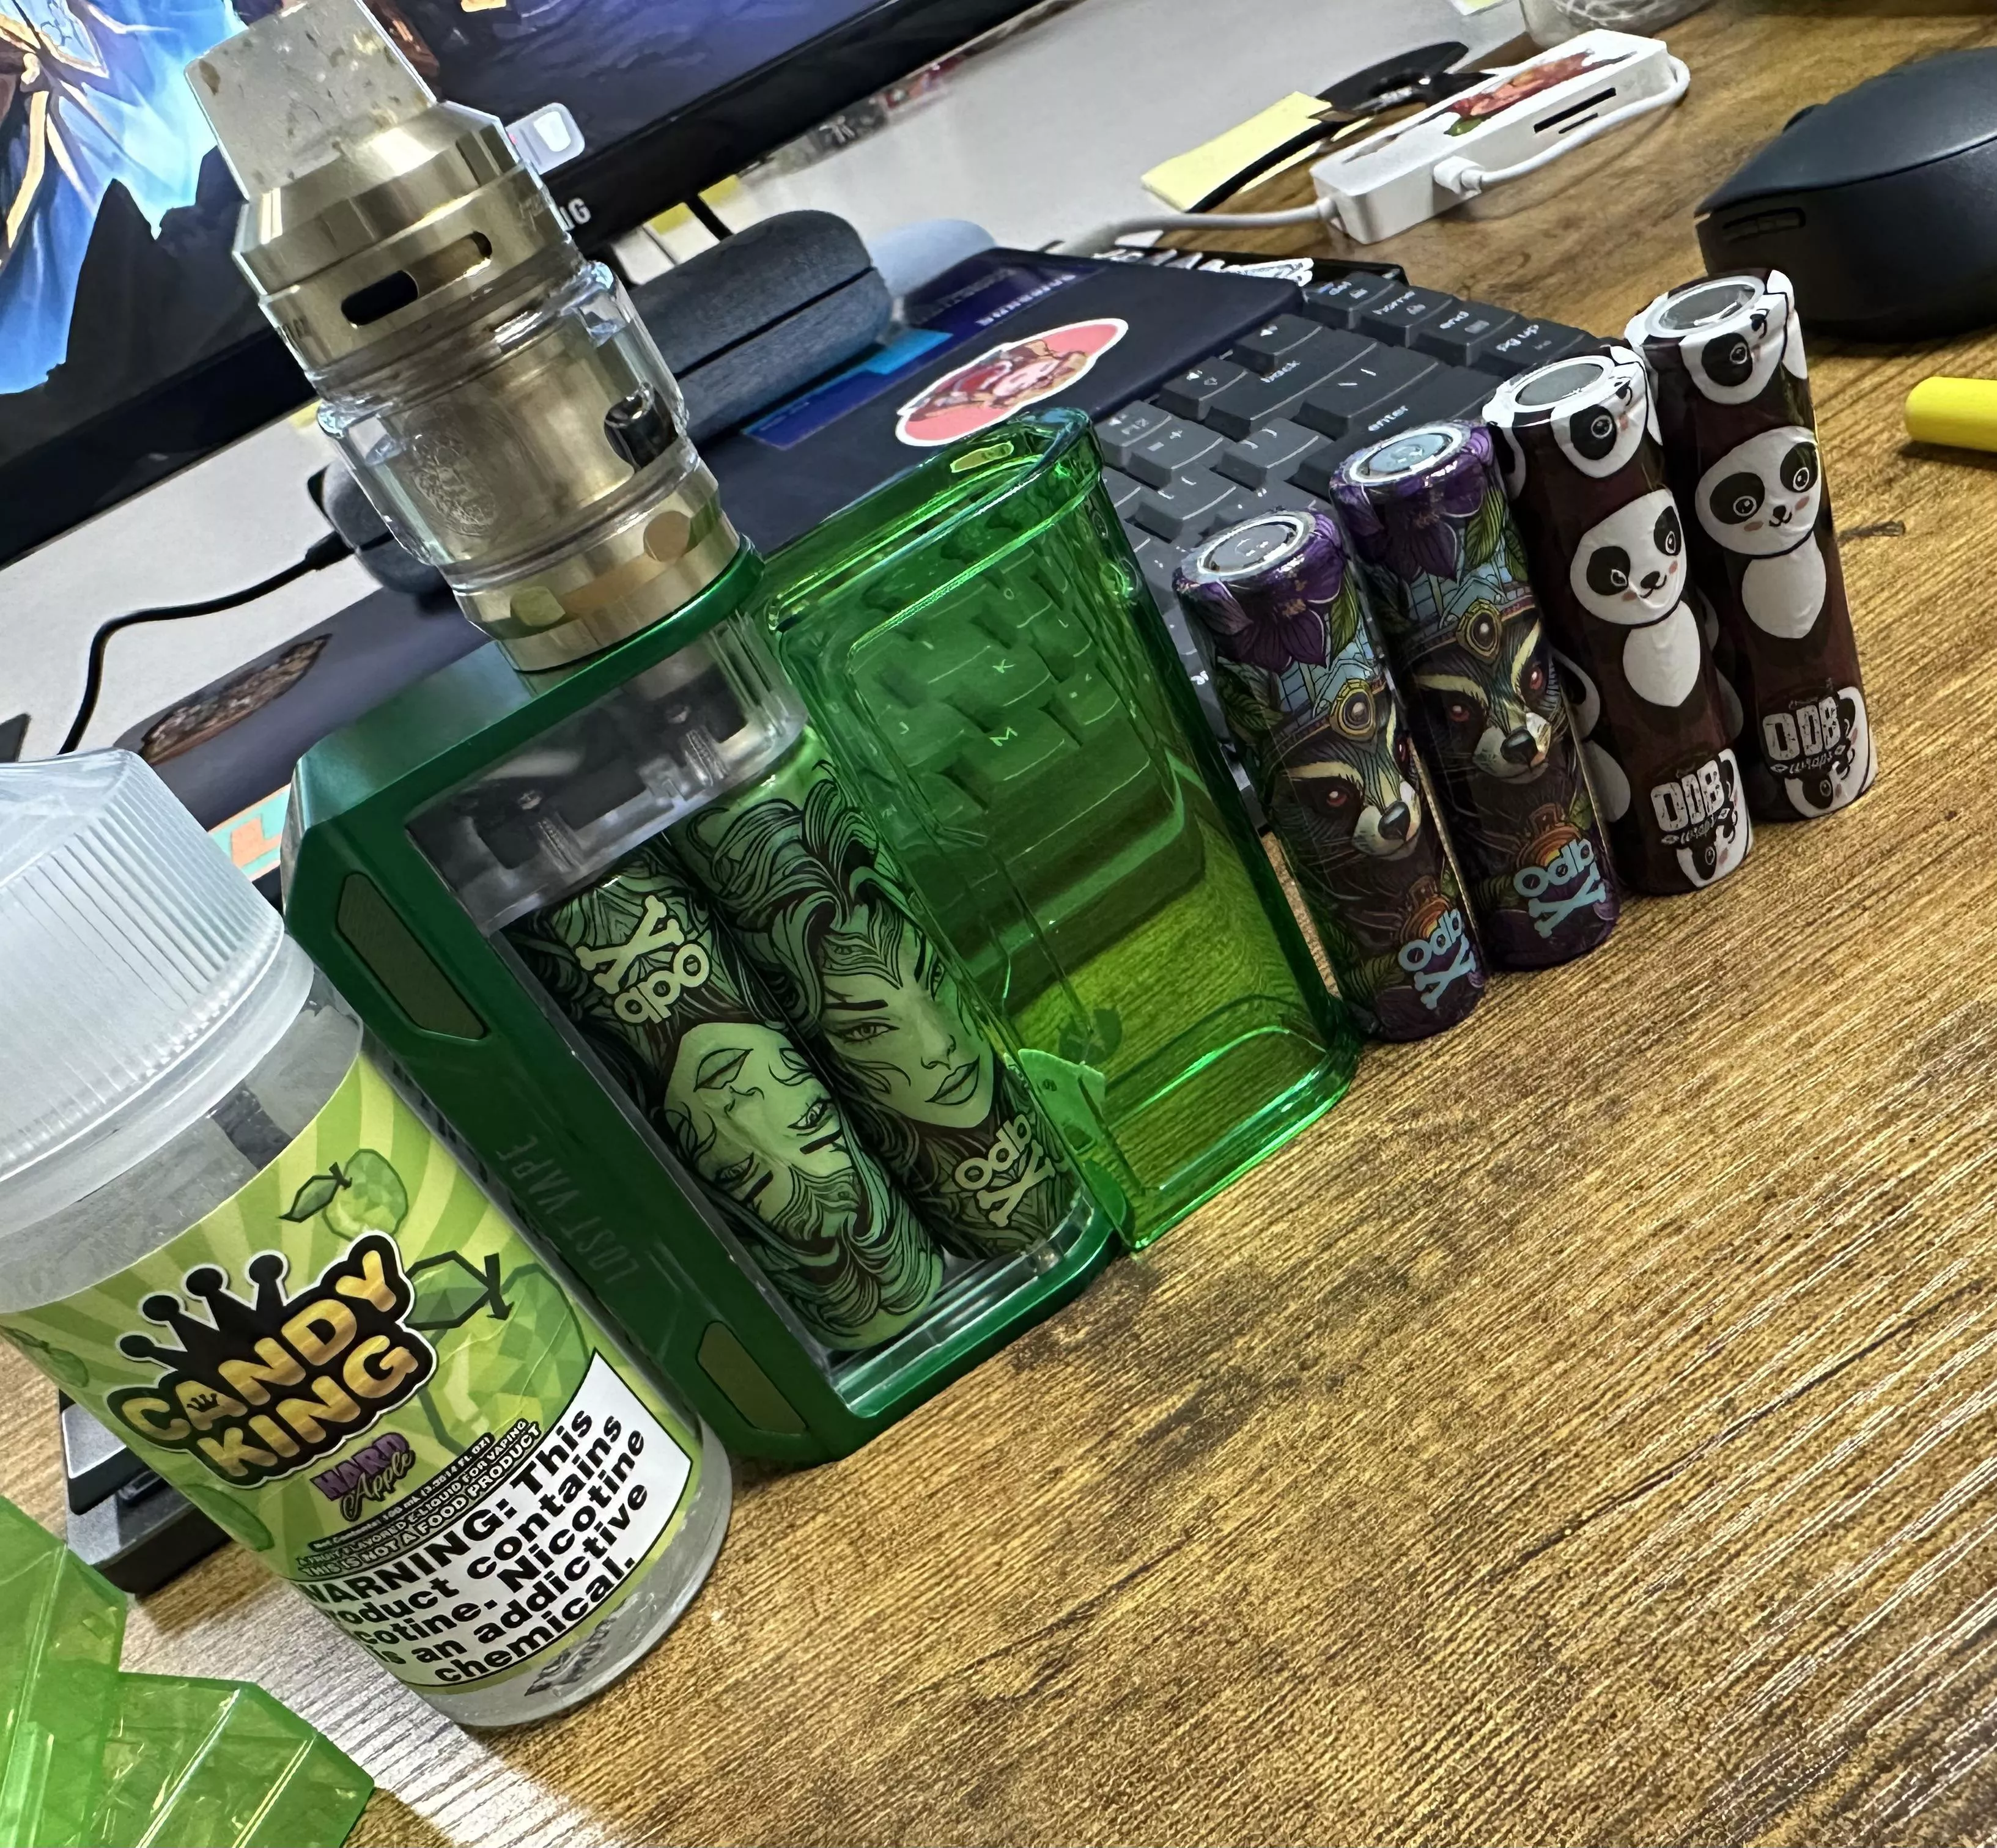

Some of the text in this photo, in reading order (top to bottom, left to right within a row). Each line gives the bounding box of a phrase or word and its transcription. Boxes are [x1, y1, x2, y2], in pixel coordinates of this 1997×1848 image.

[1260, 360, 1301, 383] back
[1368, 405, 1408, 431] enter
[992, 658, 1016, 673] K
[989, 726, 1018, 747] M
[1762, 696, 1840, 760] ODB
[1651, 760, 1724, 831] ODB
[560, 1216, 640, 1284] LOST
[121, 1250, 397, 1441] CANDY
[196, 1334, 419, 1477] KING
[310, 1432, 410, 1501] HARD
[341, 1451, 416, 1522] Apple
[342, 1521, 407, 1555] FLAVORED
[407, 1482, 462, 1524] E-LIQUID
[461, 1460, 488, 1483] FOR
[486, 1420, 527, 1460] VAPING
[509, 1410, 592, 1495] This
[299, 1423, 540, 1577] THIS IS NOT A FOOD PRODUCT
[467, 1415, 622, 1580] contains
[497, 1430, 644, 1593] Nicotine
[411, 1640, 468, 1663] an
[473, 1484, 648, 1644] addictive
[435, 1557, 635, 1682] chemical.
